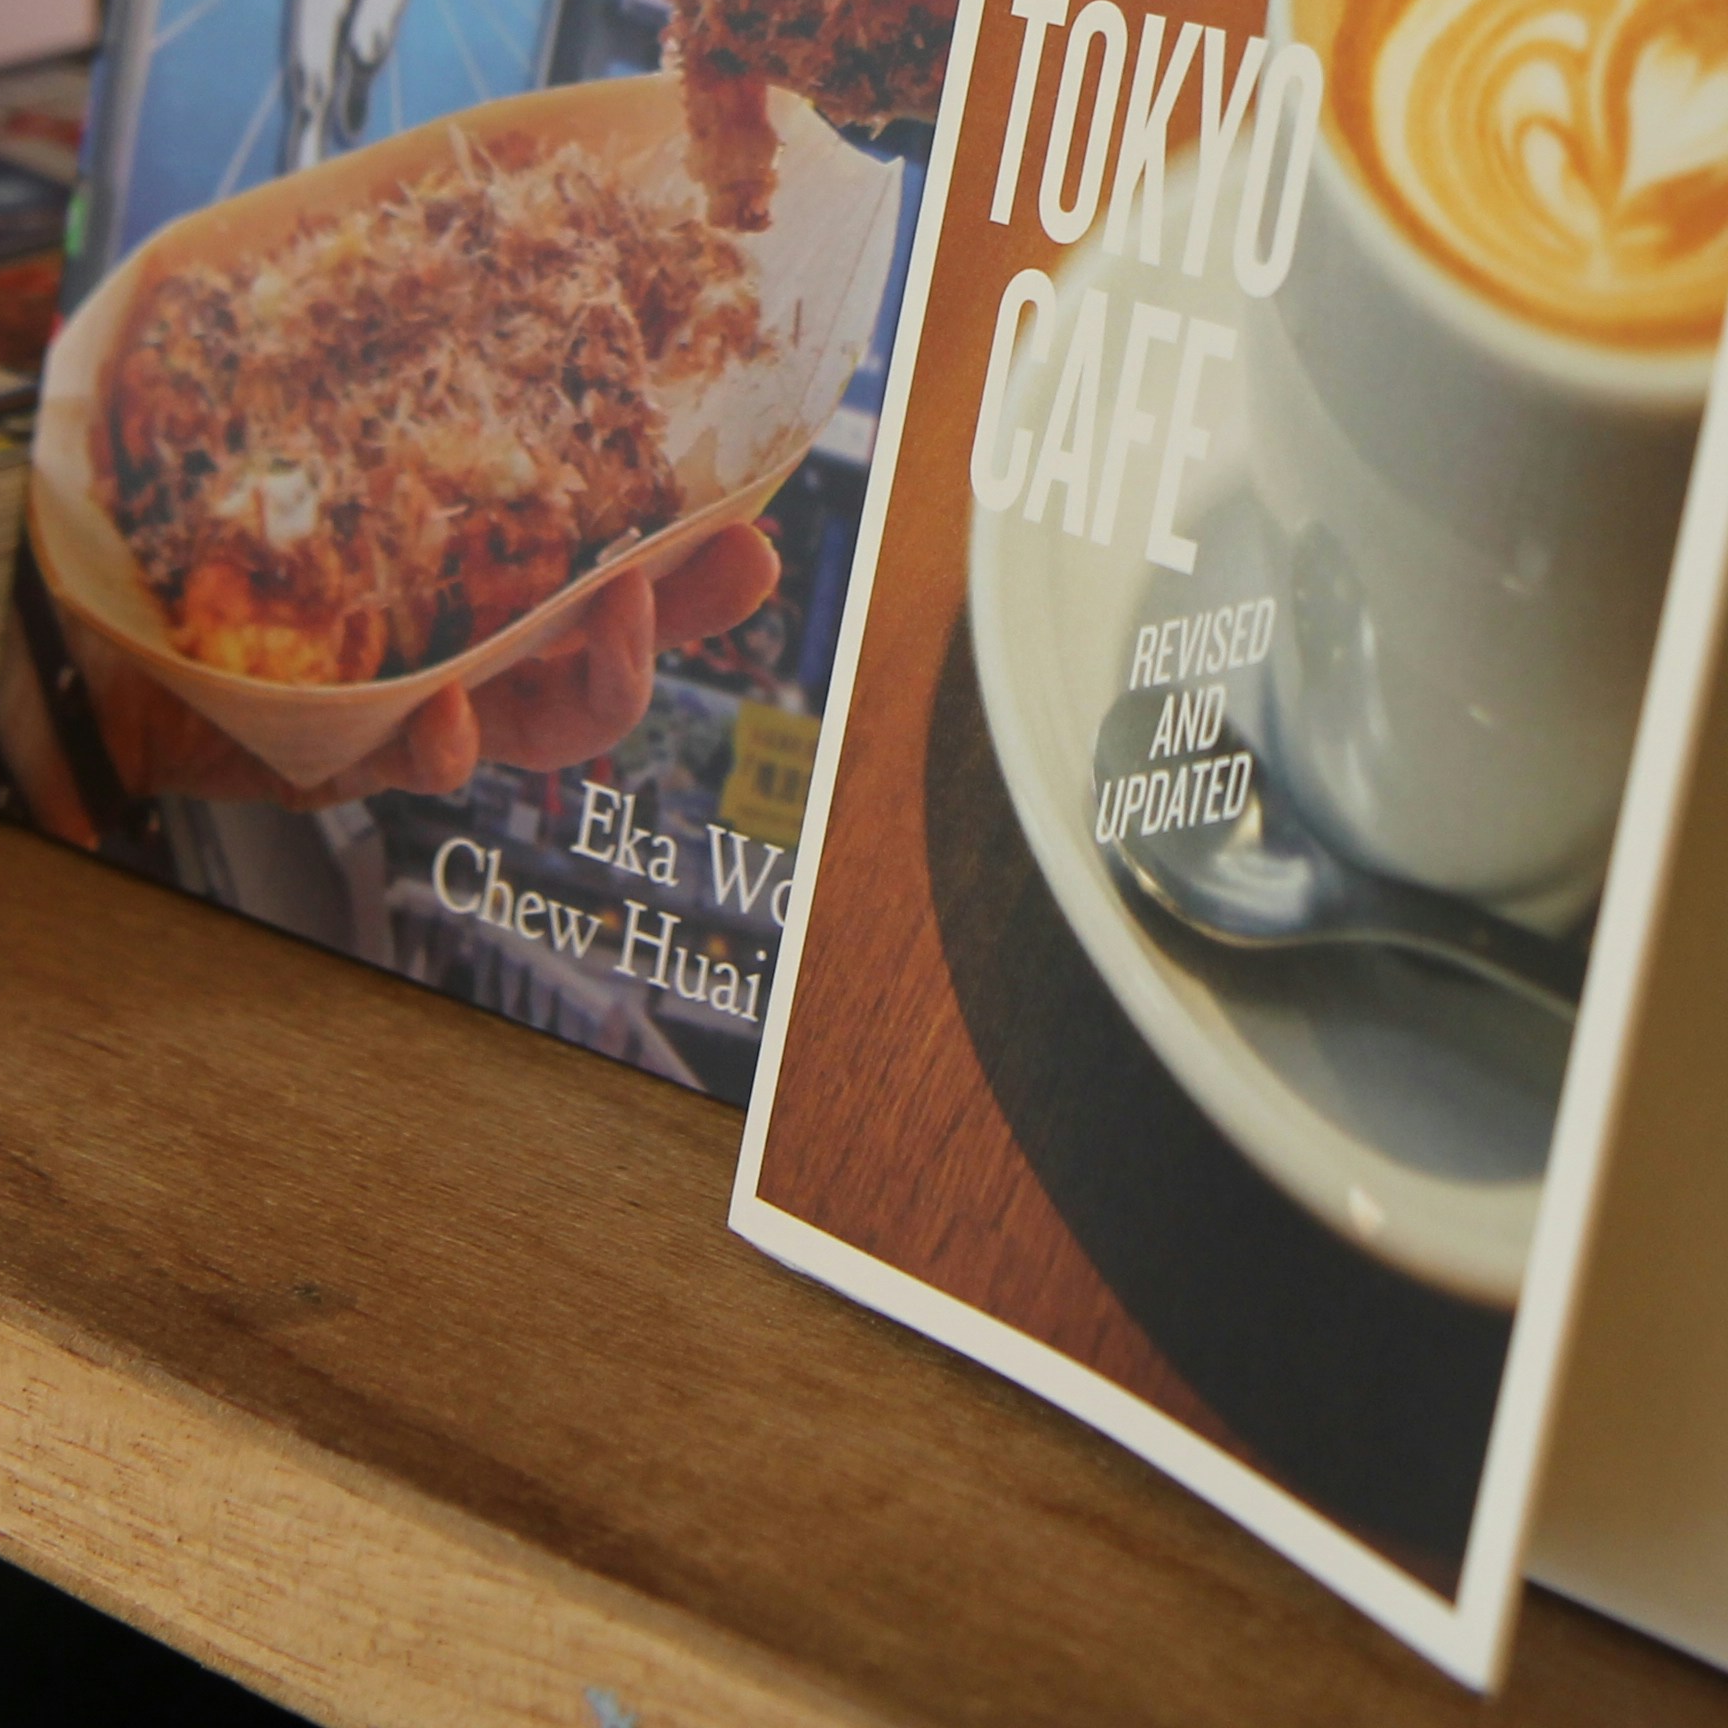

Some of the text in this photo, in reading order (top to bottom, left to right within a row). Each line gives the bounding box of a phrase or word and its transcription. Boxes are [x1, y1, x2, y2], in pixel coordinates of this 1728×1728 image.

[971, 267, 1238, 575] CAFE
[1128, 596, 1277, 691] REVISED
[1148, 684, 1226, 761] AND
[570, 779, 794, 928] Eka Wo
[1095, 751, 1253, 845] UPDATED
[431, 836, 768, 1023] Chew Huai
